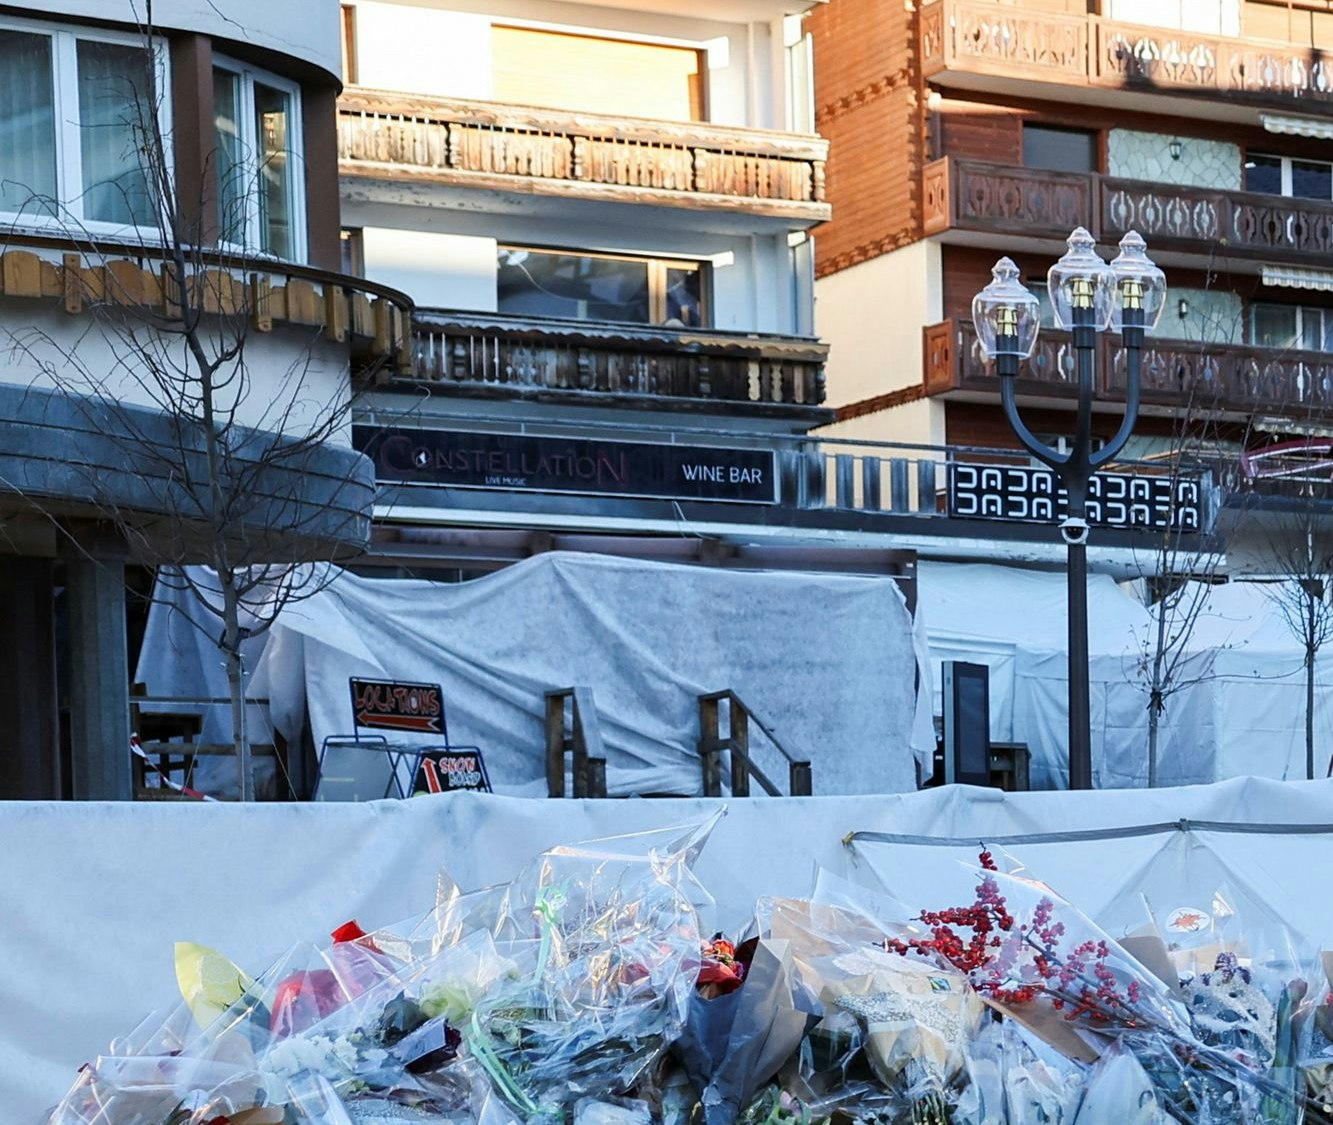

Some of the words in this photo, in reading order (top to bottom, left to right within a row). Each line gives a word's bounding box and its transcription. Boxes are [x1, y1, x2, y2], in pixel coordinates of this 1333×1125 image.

[485, 476, 500, 485] LIVE
[502, 477, 526, 486] MUSIC
[682, 464, 725, 482] WINE
[729, 466, 762, 484] BAR
[354, 684, 440, 716] LOCATIONS
[439, 757, 475, 774] SNOW
